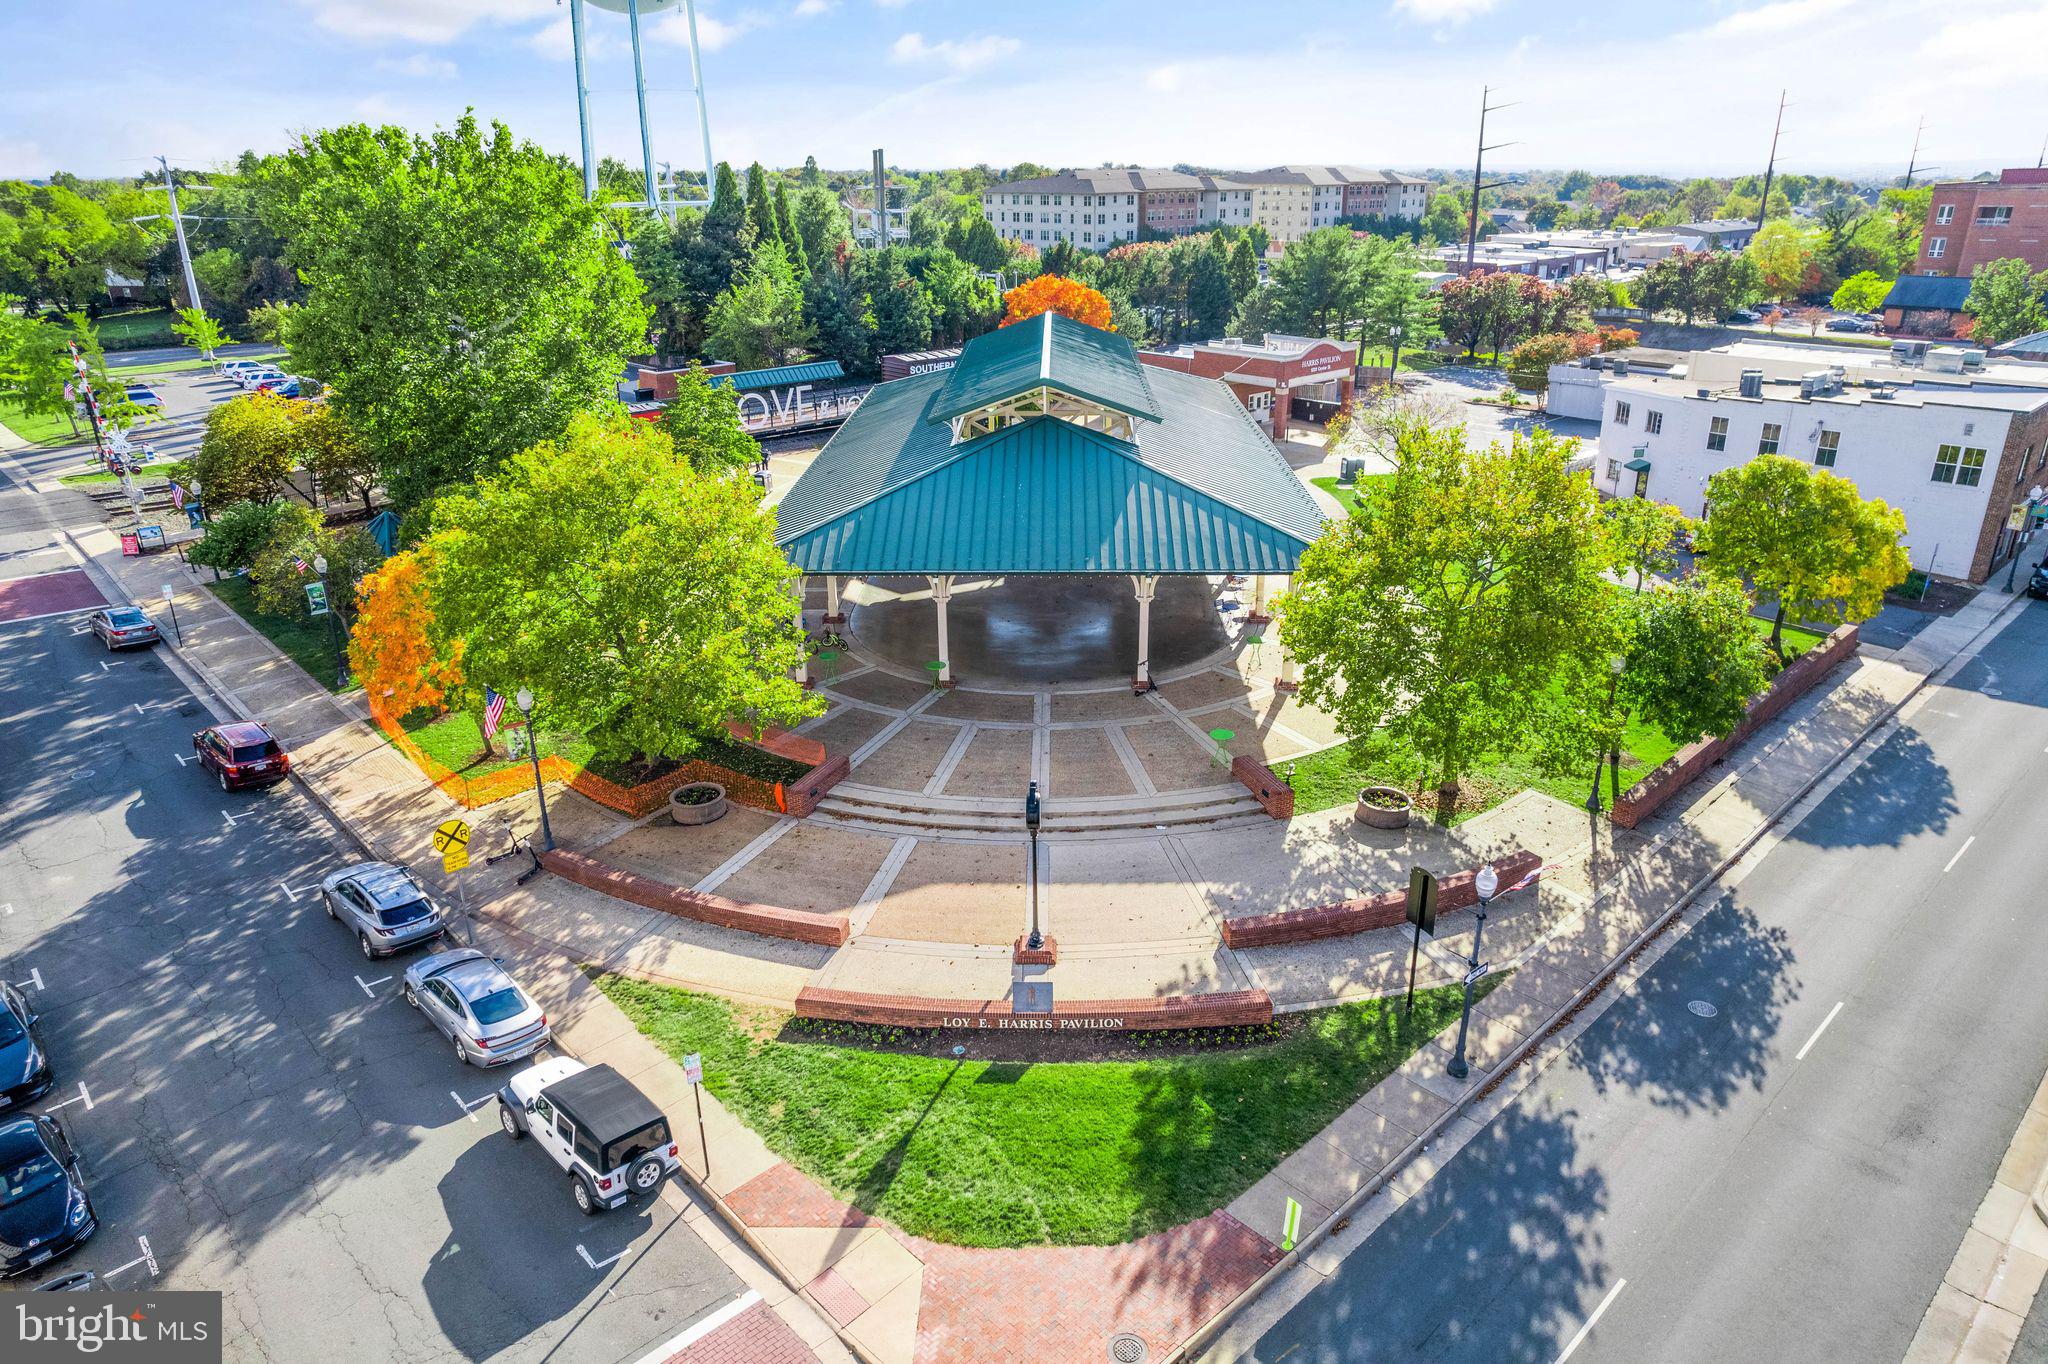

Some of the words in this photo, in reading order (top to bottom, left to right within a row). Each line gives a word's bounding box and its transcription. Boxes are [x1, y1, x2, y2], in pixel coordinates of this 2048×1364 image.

[1301, 359, 1320, 368] HARRIS
[1320, 355, 1341, 364] PAVILION
[736, 384, 813, 430] OVE
[436, 836, 444, 846] R
[460, 829, 468, 838] R
[943, 1017, 971, 1028] LOY
[978, 1018, 991, 1028] E.
[999, 1019, 1053, 1029] HARRIS
[1060, 1018, 1124, 1029] PAVILION
